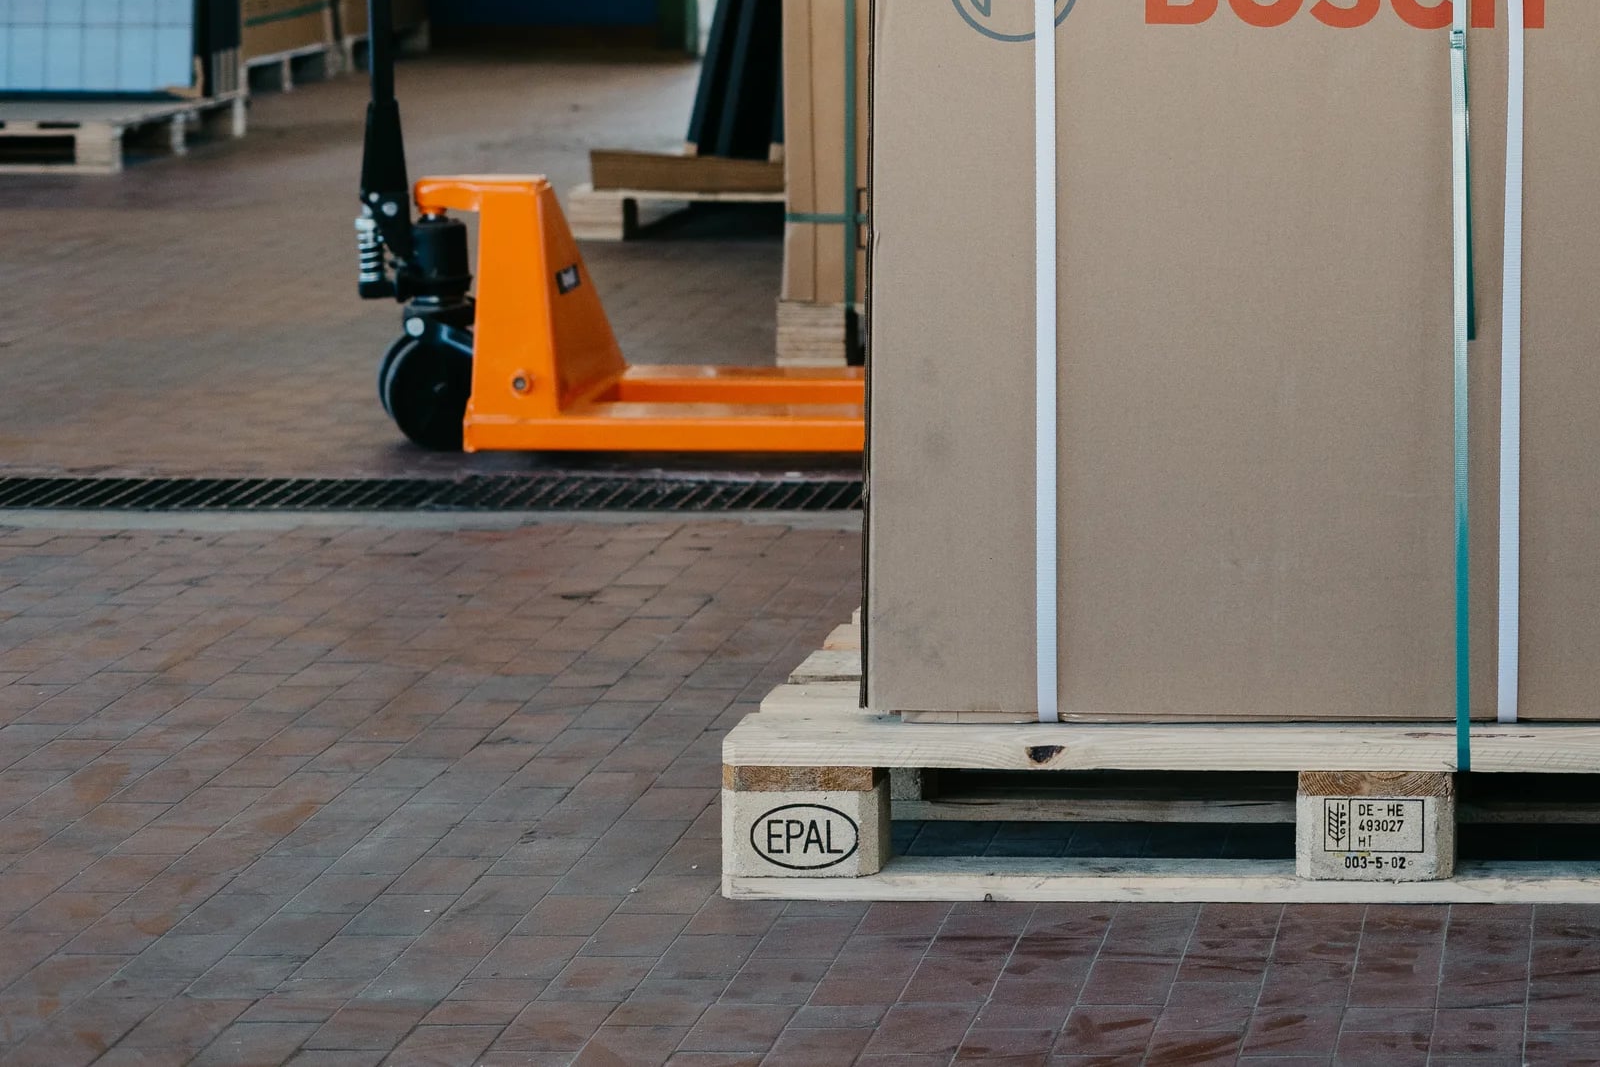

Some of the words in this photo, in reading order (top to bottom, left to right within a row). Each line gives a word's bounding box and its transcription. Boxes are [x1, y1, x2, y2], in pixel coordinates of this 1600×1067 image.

[1359, 804, 1374, 816] DE
[1388, 804, 1404, 816] HE
[1359, 820, 1404, 832] 493027
[767, 820, 843, 854] EPAL
[1345, 856, 1406, 869] 003-5-02
